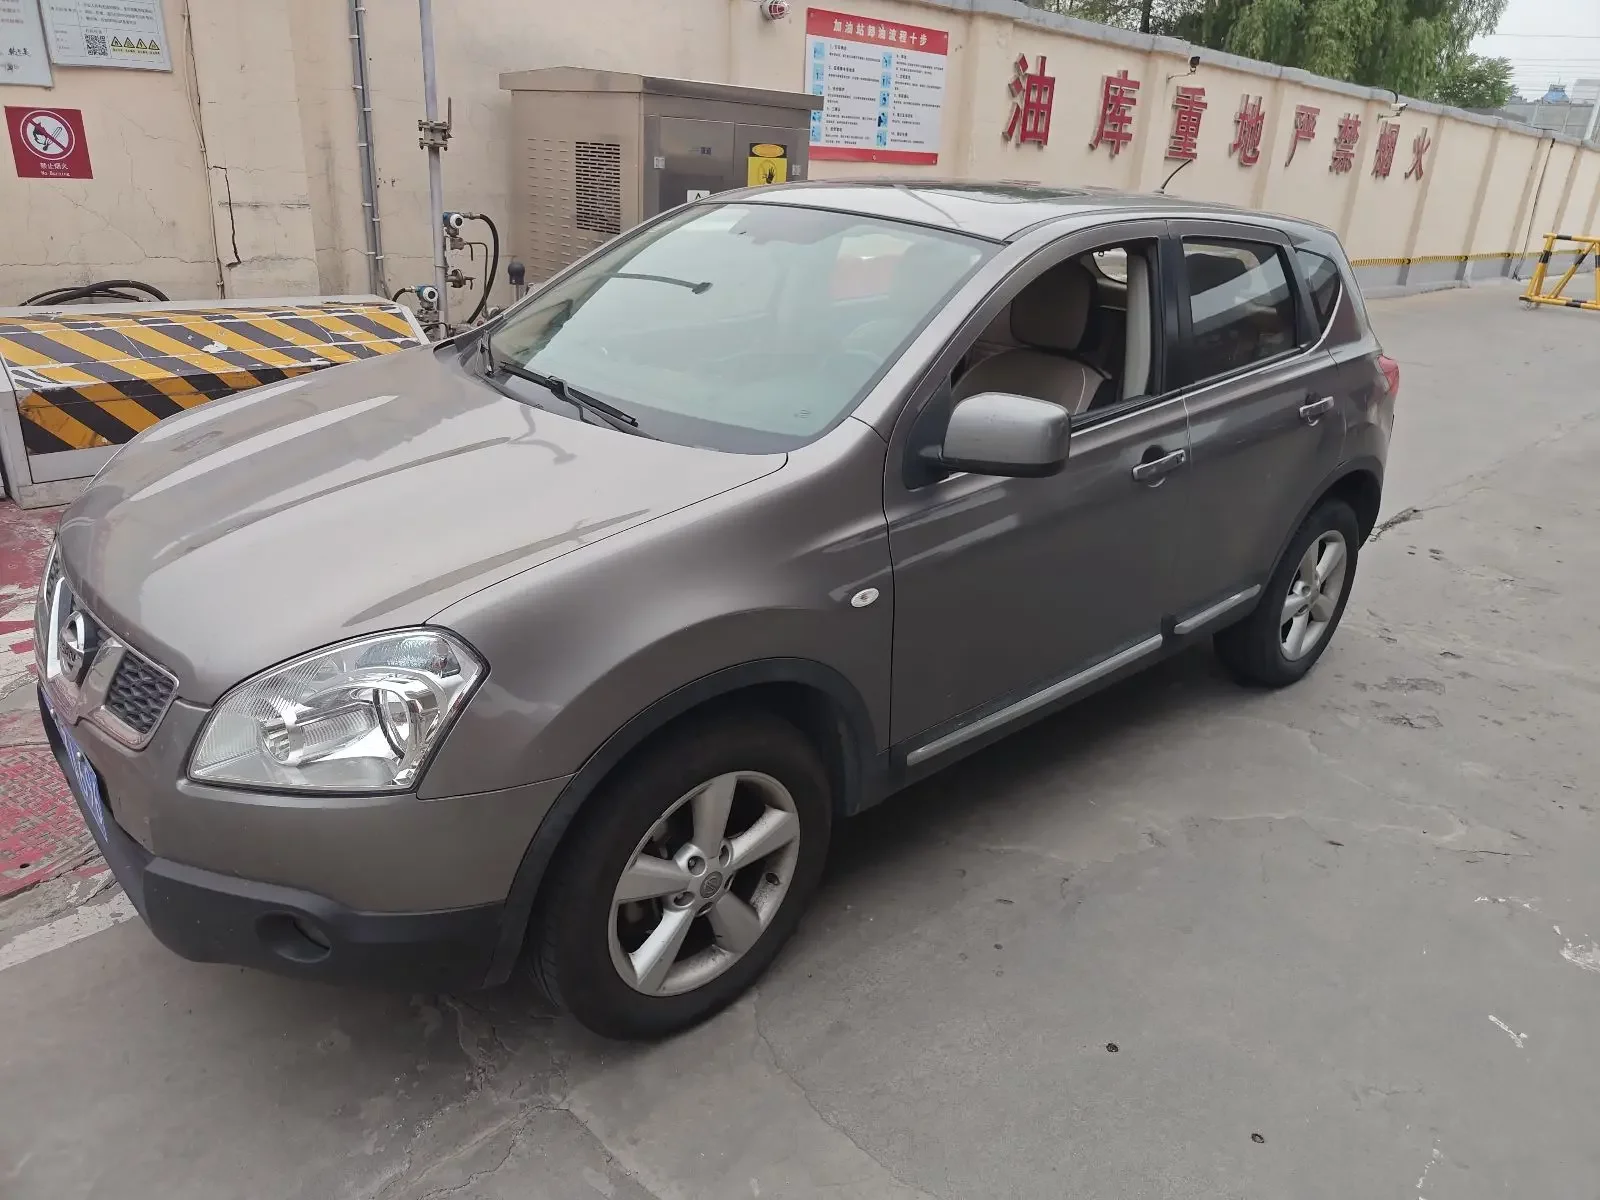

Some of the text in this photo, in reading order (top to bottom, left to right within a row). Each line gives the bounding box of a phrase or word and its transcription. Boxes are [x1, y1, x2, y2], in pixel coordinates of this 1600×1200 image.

[833, 19, 929, 46] 加油站卸油流程十步
[1002, 52, 1431, 181] 油库重地严禁烟火
